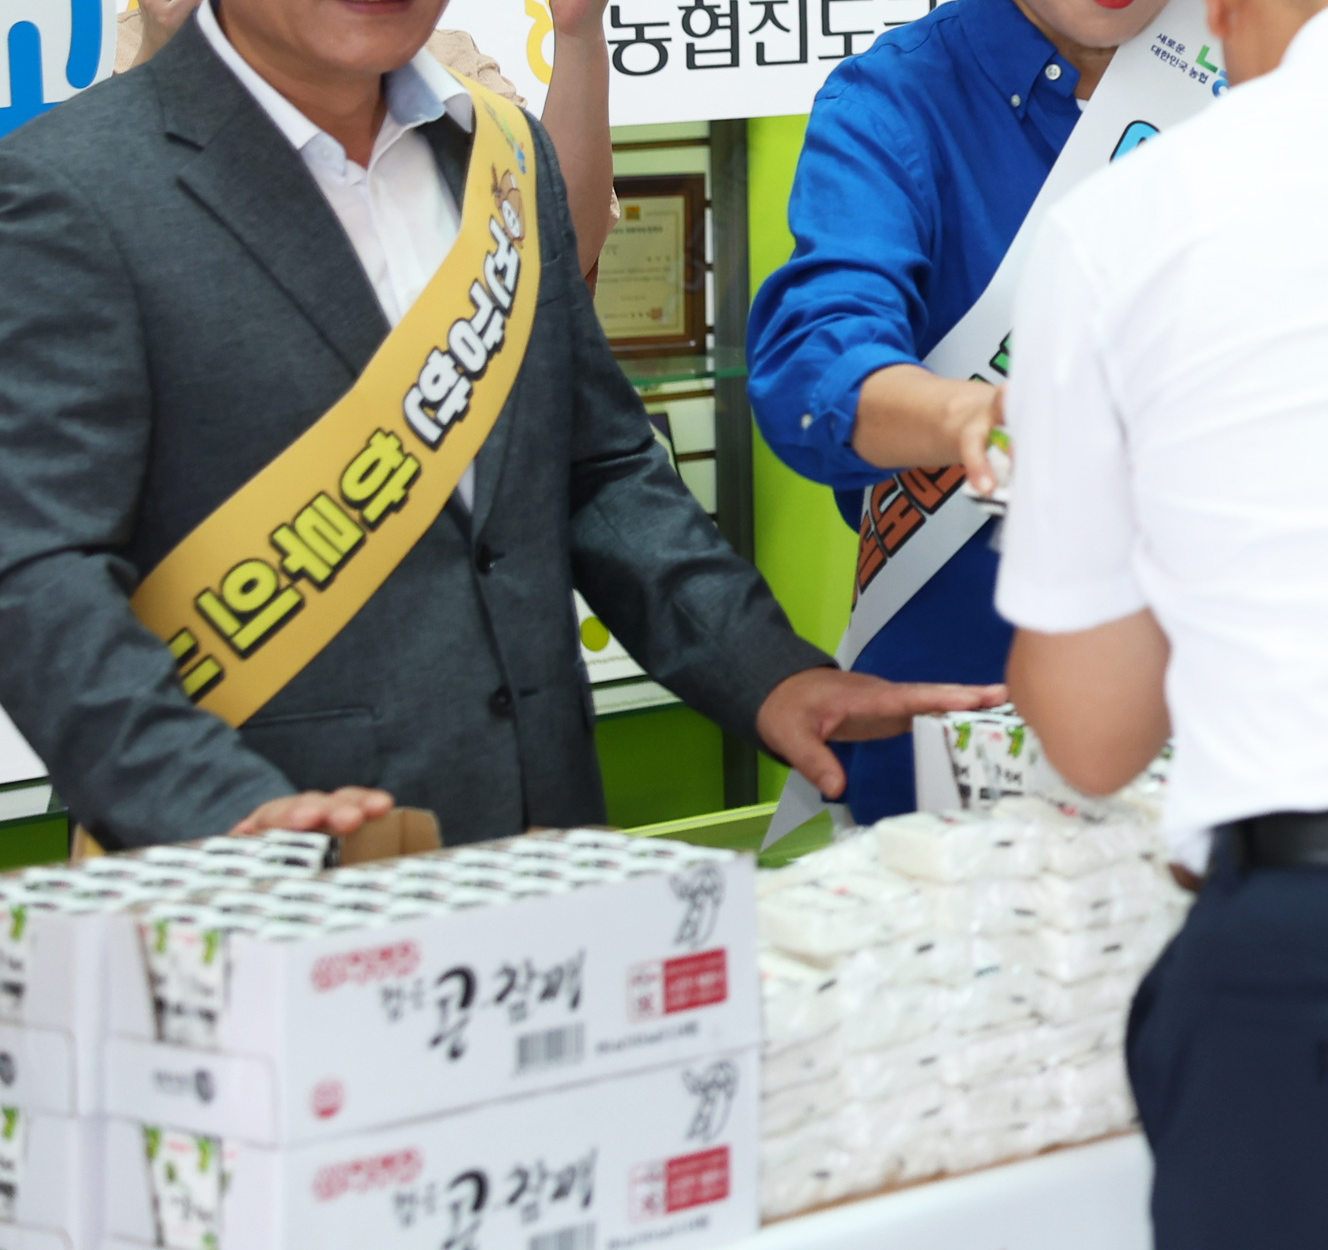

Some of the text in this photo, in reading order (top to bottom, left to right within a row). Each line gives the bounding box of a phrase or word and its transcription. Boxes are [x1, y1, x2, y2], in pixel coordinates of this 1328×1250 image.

[1157, 33, 1186, 55] 새로운
[1151, 45, 1188, 73] 대한민국
[1189, 67, 1209, 84] 농협
[193, 427, 422, 658] 하루의
